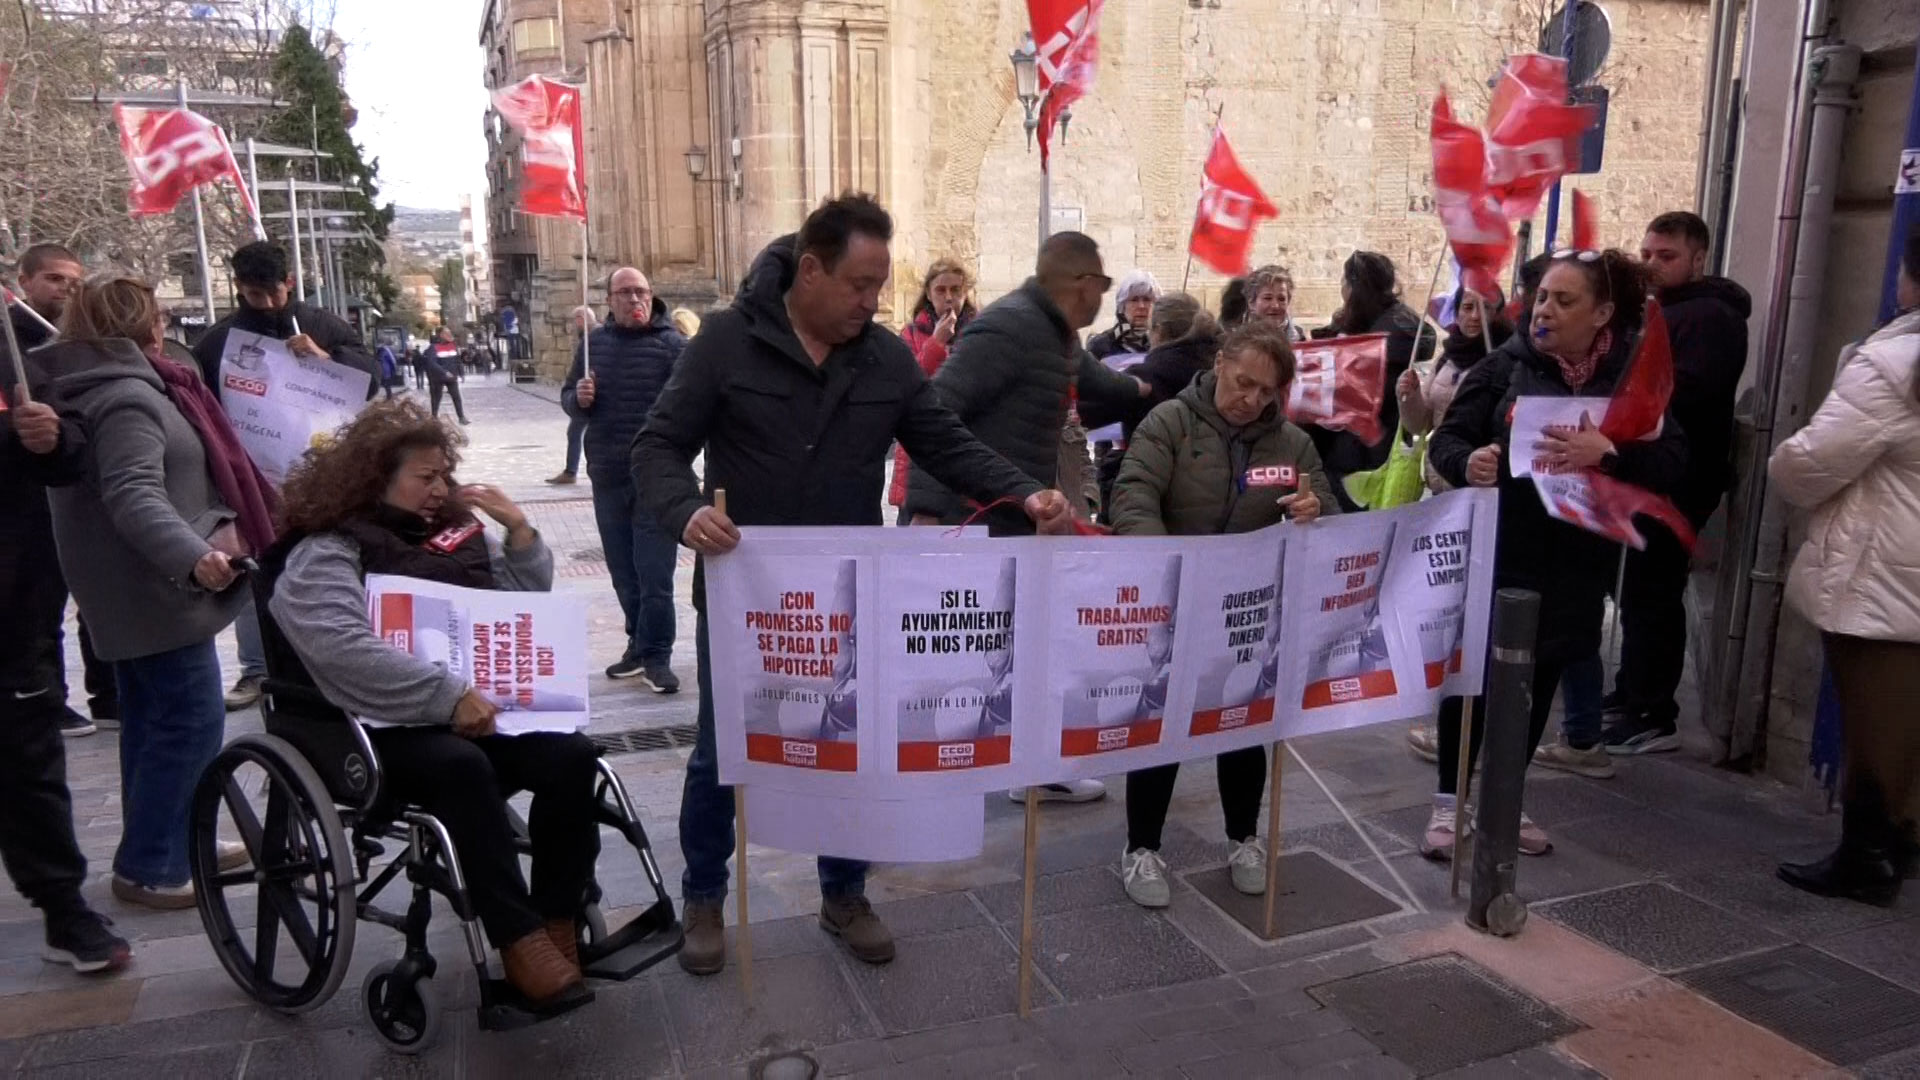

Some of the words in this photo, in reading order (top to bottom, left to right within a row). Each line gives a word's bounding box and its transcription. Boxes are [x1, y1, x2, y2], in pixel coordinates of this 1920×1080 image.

[226, 376, 265, 394] CCOO
[247, 408, 259, 418] DE
[231, 419, 282, 440] RTAGENA
[1346, 572, 1366, 590] BIEN
[780, 591, 815, 610] ¡CON
[940, 589, 960, 609] ¡SI
[964, 589, 981, 608] EL
[1116, 586, 1140, 605] ¡NO
[1222, 584, 1275, 611] ¡QUEREMOS
[746, 611, 824, 632] PROMESAS
[829, 613, 850, 632] NO
[901, 611, 1012, 631] AYUNTAMIENTO
[1076, 606, 1170, 625] TRABAJAMOS
[1225, 606, 1269, 628] NUESTRO
[494, 621, 511, 637] SE
[1097, 627, 1149, 646] GRATIS!
[1228, 626, 1265, 648] DINERO
[515, 613, 533, 684] PROMESAS
[757, 633, 774, 652] SE
[777, 635, 815, 654] PAGA
[820, 637, 838, 654] LA
[906, 635, 926, 654] NO
[931, 635, 961, 654] NOS
[965, 632, 1007, 652] PAGA!
[494, 641, 512, 674] PAGA
[536, 646, 554, 676] ¡CON
[1237, 648, 1254, 663] YA!
[763, 655, 834, 678] HIPOTECA!
[494, 680, 512, 696] LA
[955, 697, 967, 708] LO
[784, 743, 815, 754] CCOO
[940, 745, 973, 754] CCOO
